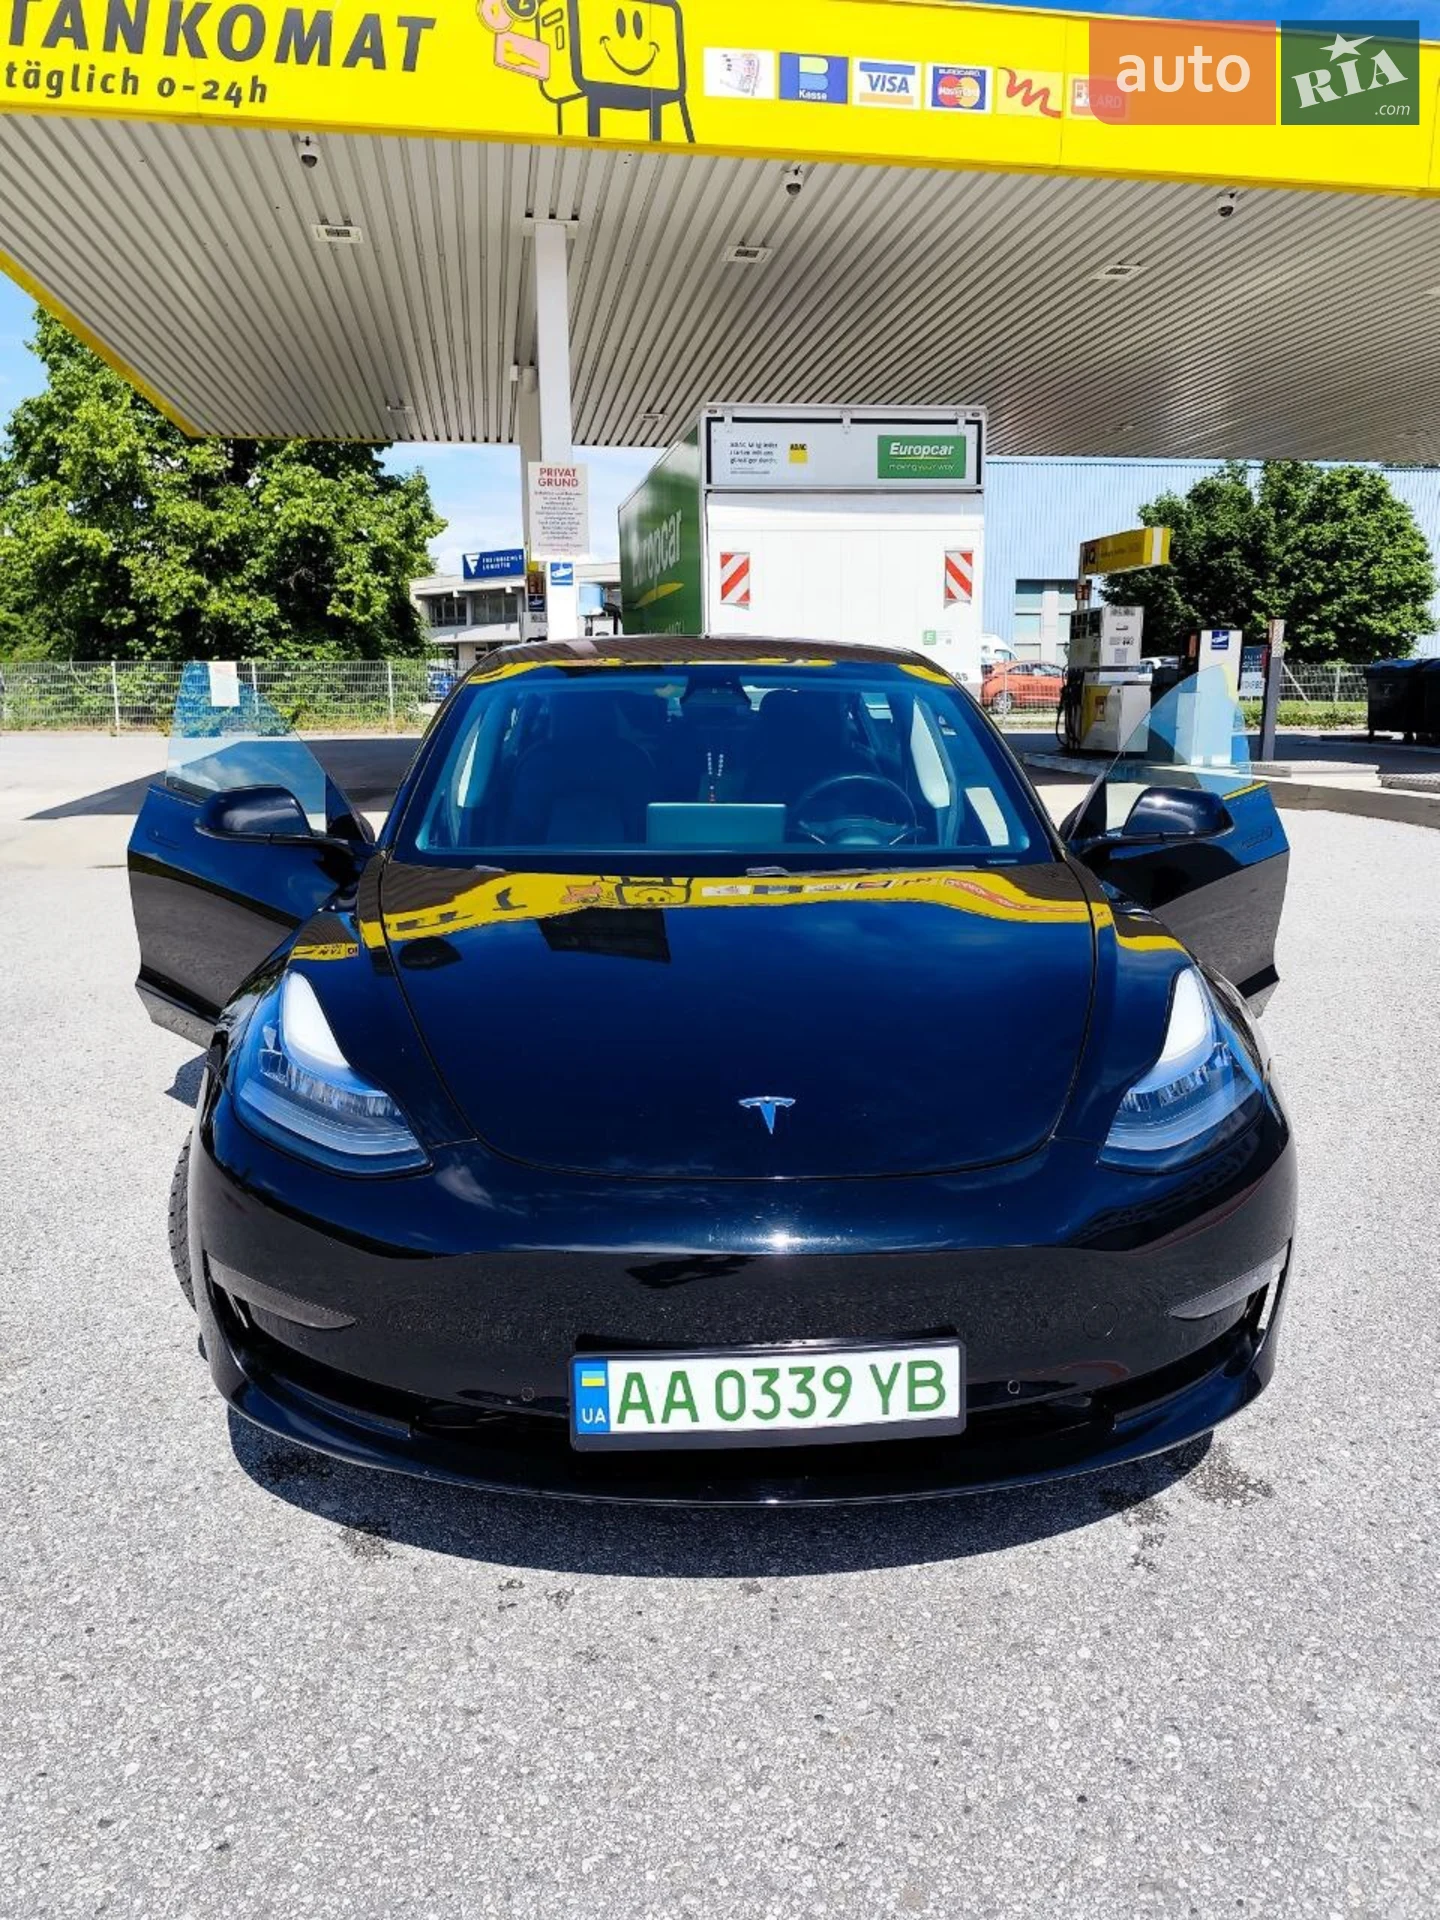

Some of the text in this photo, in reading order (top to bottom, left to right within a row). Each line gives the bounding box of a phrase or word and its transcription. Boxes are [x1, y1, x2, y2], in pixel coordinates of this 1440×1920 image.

[8, 0, 437, 72] TANKOMAT
[5, 59, 139, 98] täglich
[867, 74, 910, 93] VISA
[799, 89, 828, 100] Kasse
[889, 442, 954, 459] Europcar
[539, 467, 576, 477] PRIVAT
[538, 478, 579, 487] GRUND
[616, 1359, 947, 1425] AA 0339 YB
[581, 1407, 607, 1424] UA
